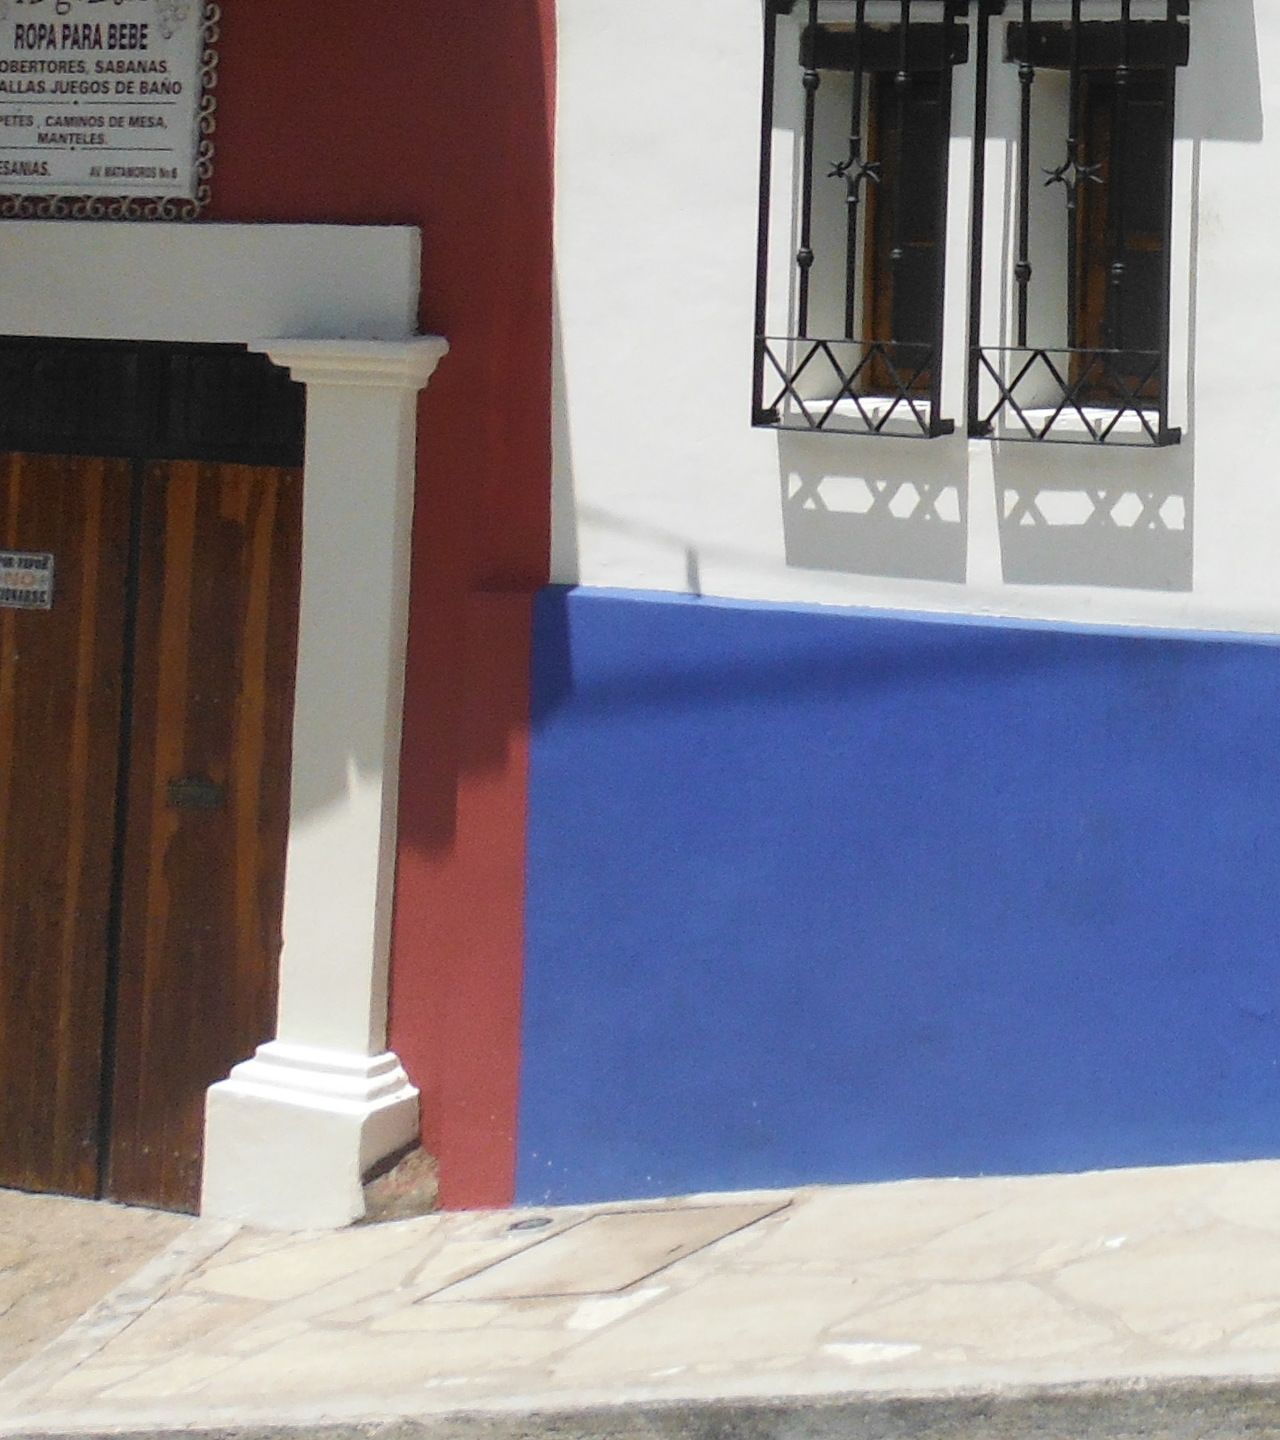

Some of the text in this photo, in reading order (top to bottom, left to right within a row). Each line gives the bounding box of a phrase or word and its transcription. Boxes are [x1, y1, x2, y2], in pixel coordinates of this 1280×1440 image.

[14, 23, 148, 50] ROPA PARA BEBE
[50, 80, 110, 95] JUEGOS
[115, 80, 135, 95] DE
[139, 77, 182, 95] BAÑO
[109, 116, 125, 129] DE
